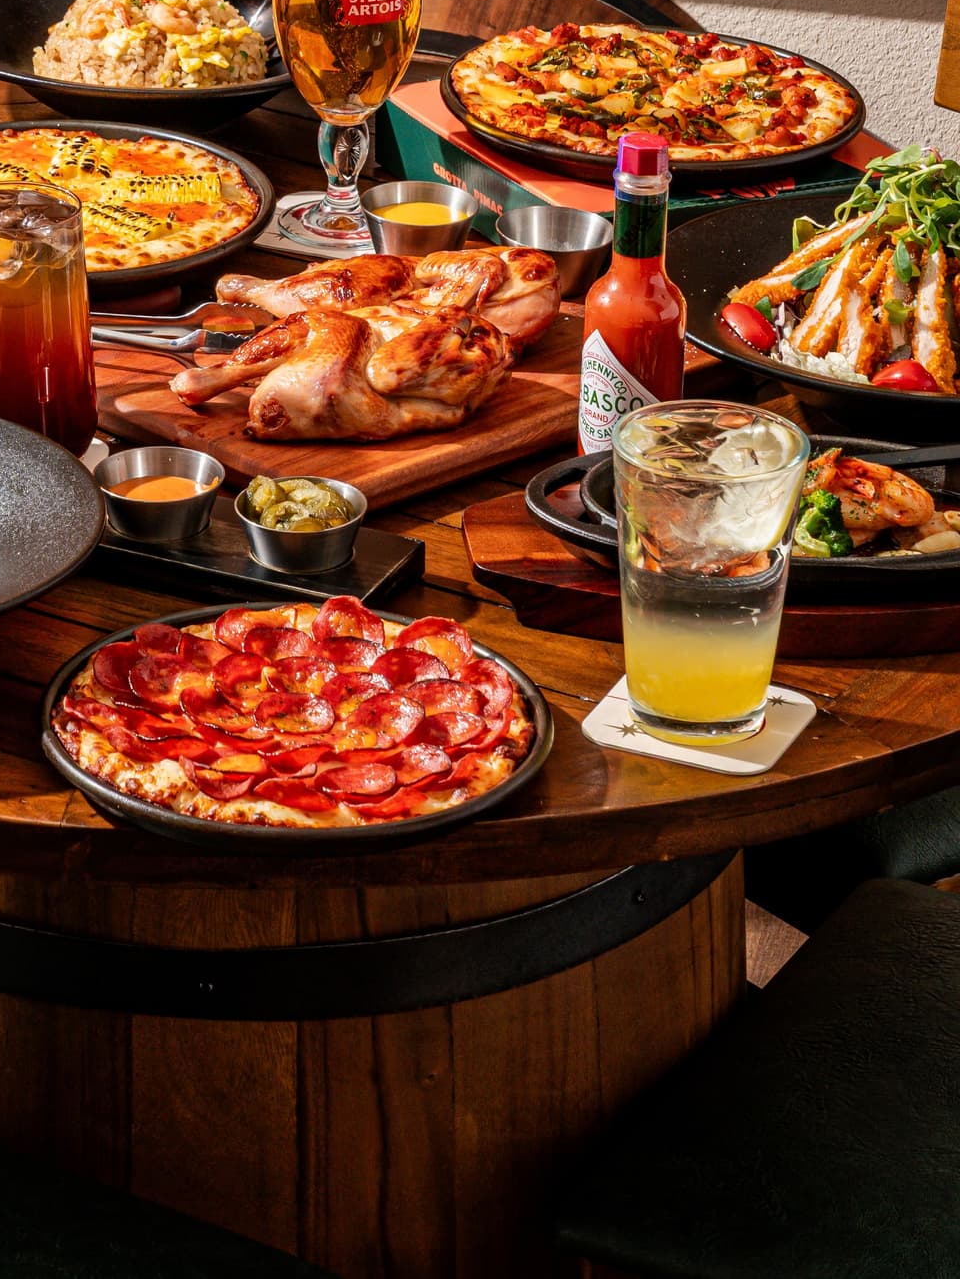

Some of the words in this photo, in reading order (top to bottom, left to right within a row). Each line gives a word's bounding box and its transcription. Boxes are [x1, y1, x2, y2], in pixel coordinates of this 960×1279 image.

[348, 0, 401, 16] ARTOIS
[583, 384, 644, 414] BASCO
[584, 407, 609, 423] BRAND
